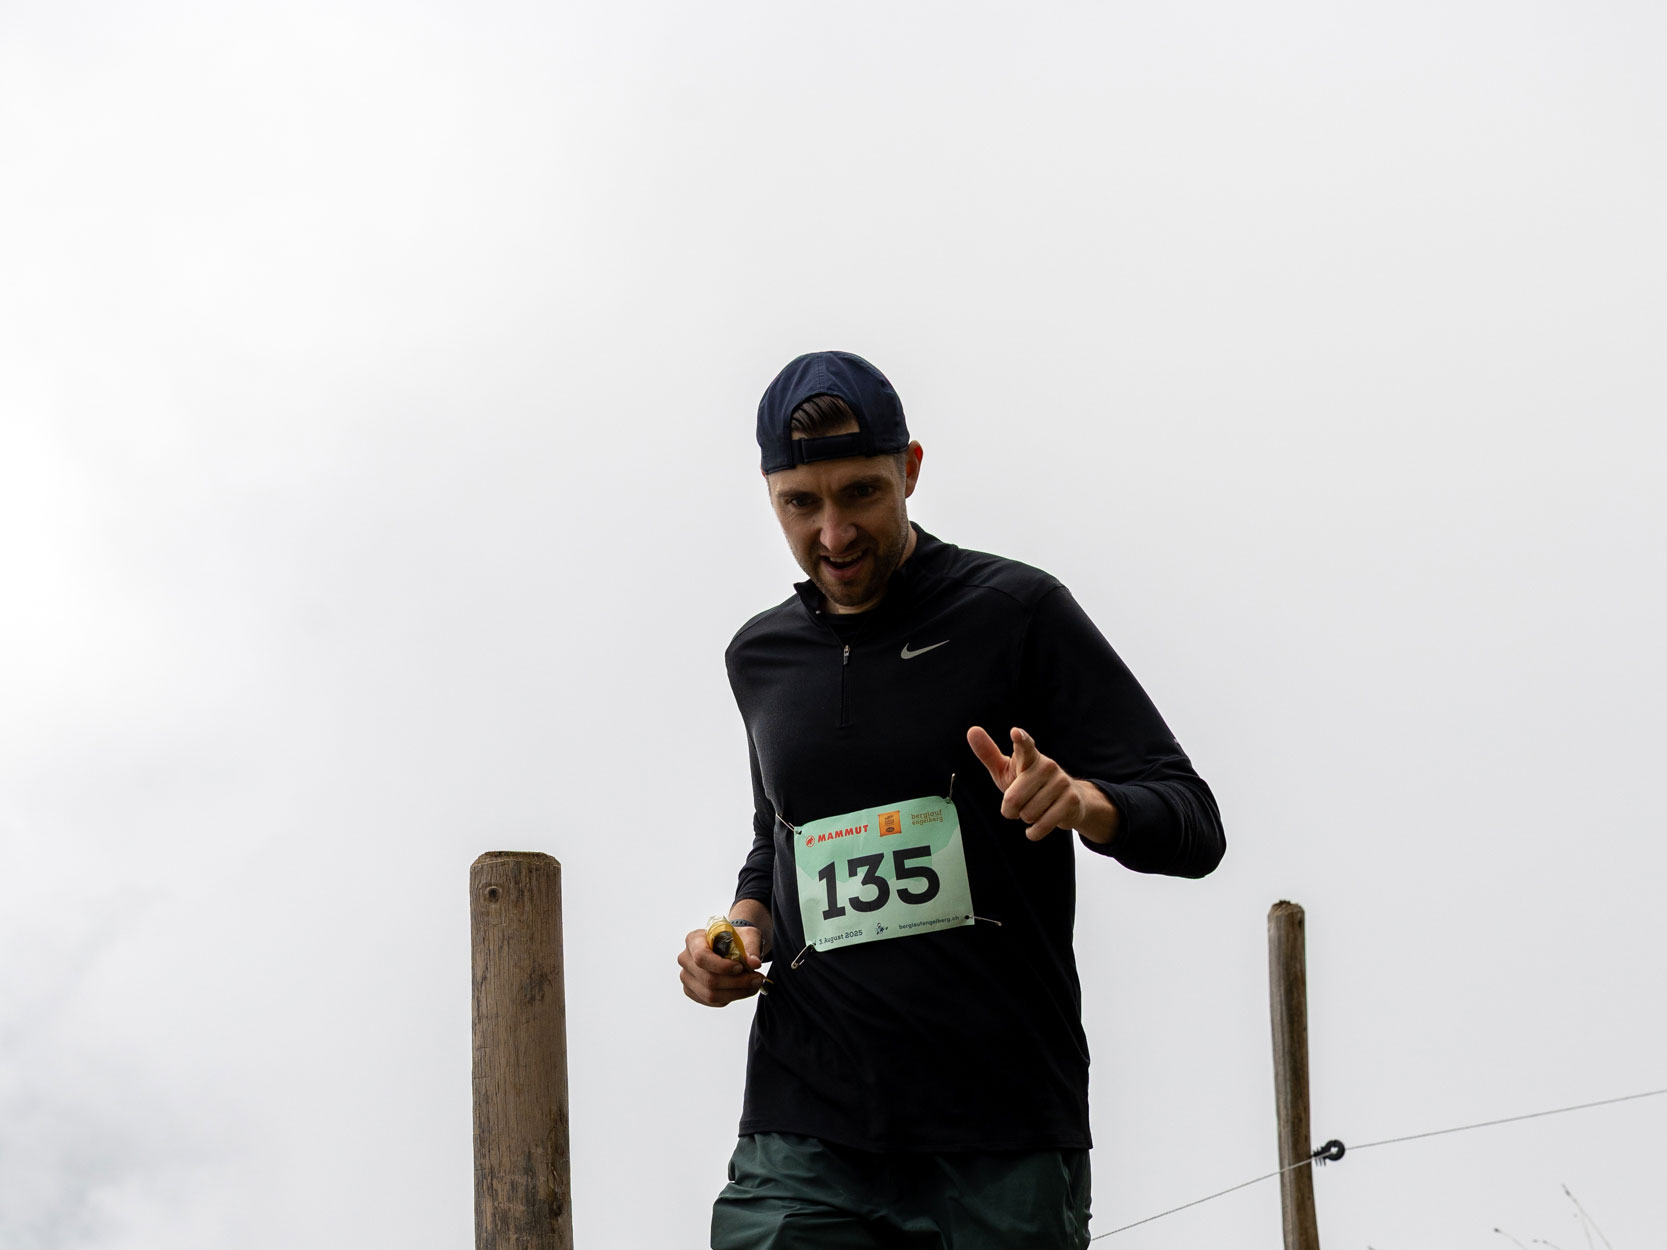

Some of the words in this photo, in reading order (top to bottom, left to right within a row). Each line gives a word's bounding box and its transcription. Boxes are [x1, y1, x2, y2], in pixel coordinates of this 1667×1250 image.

[817, 824, 868, 843] MAMMUT
[818, 845, 940, 921] 135
[824, 934, 844, 943] August
[844, 929, 863, 939] 2025
